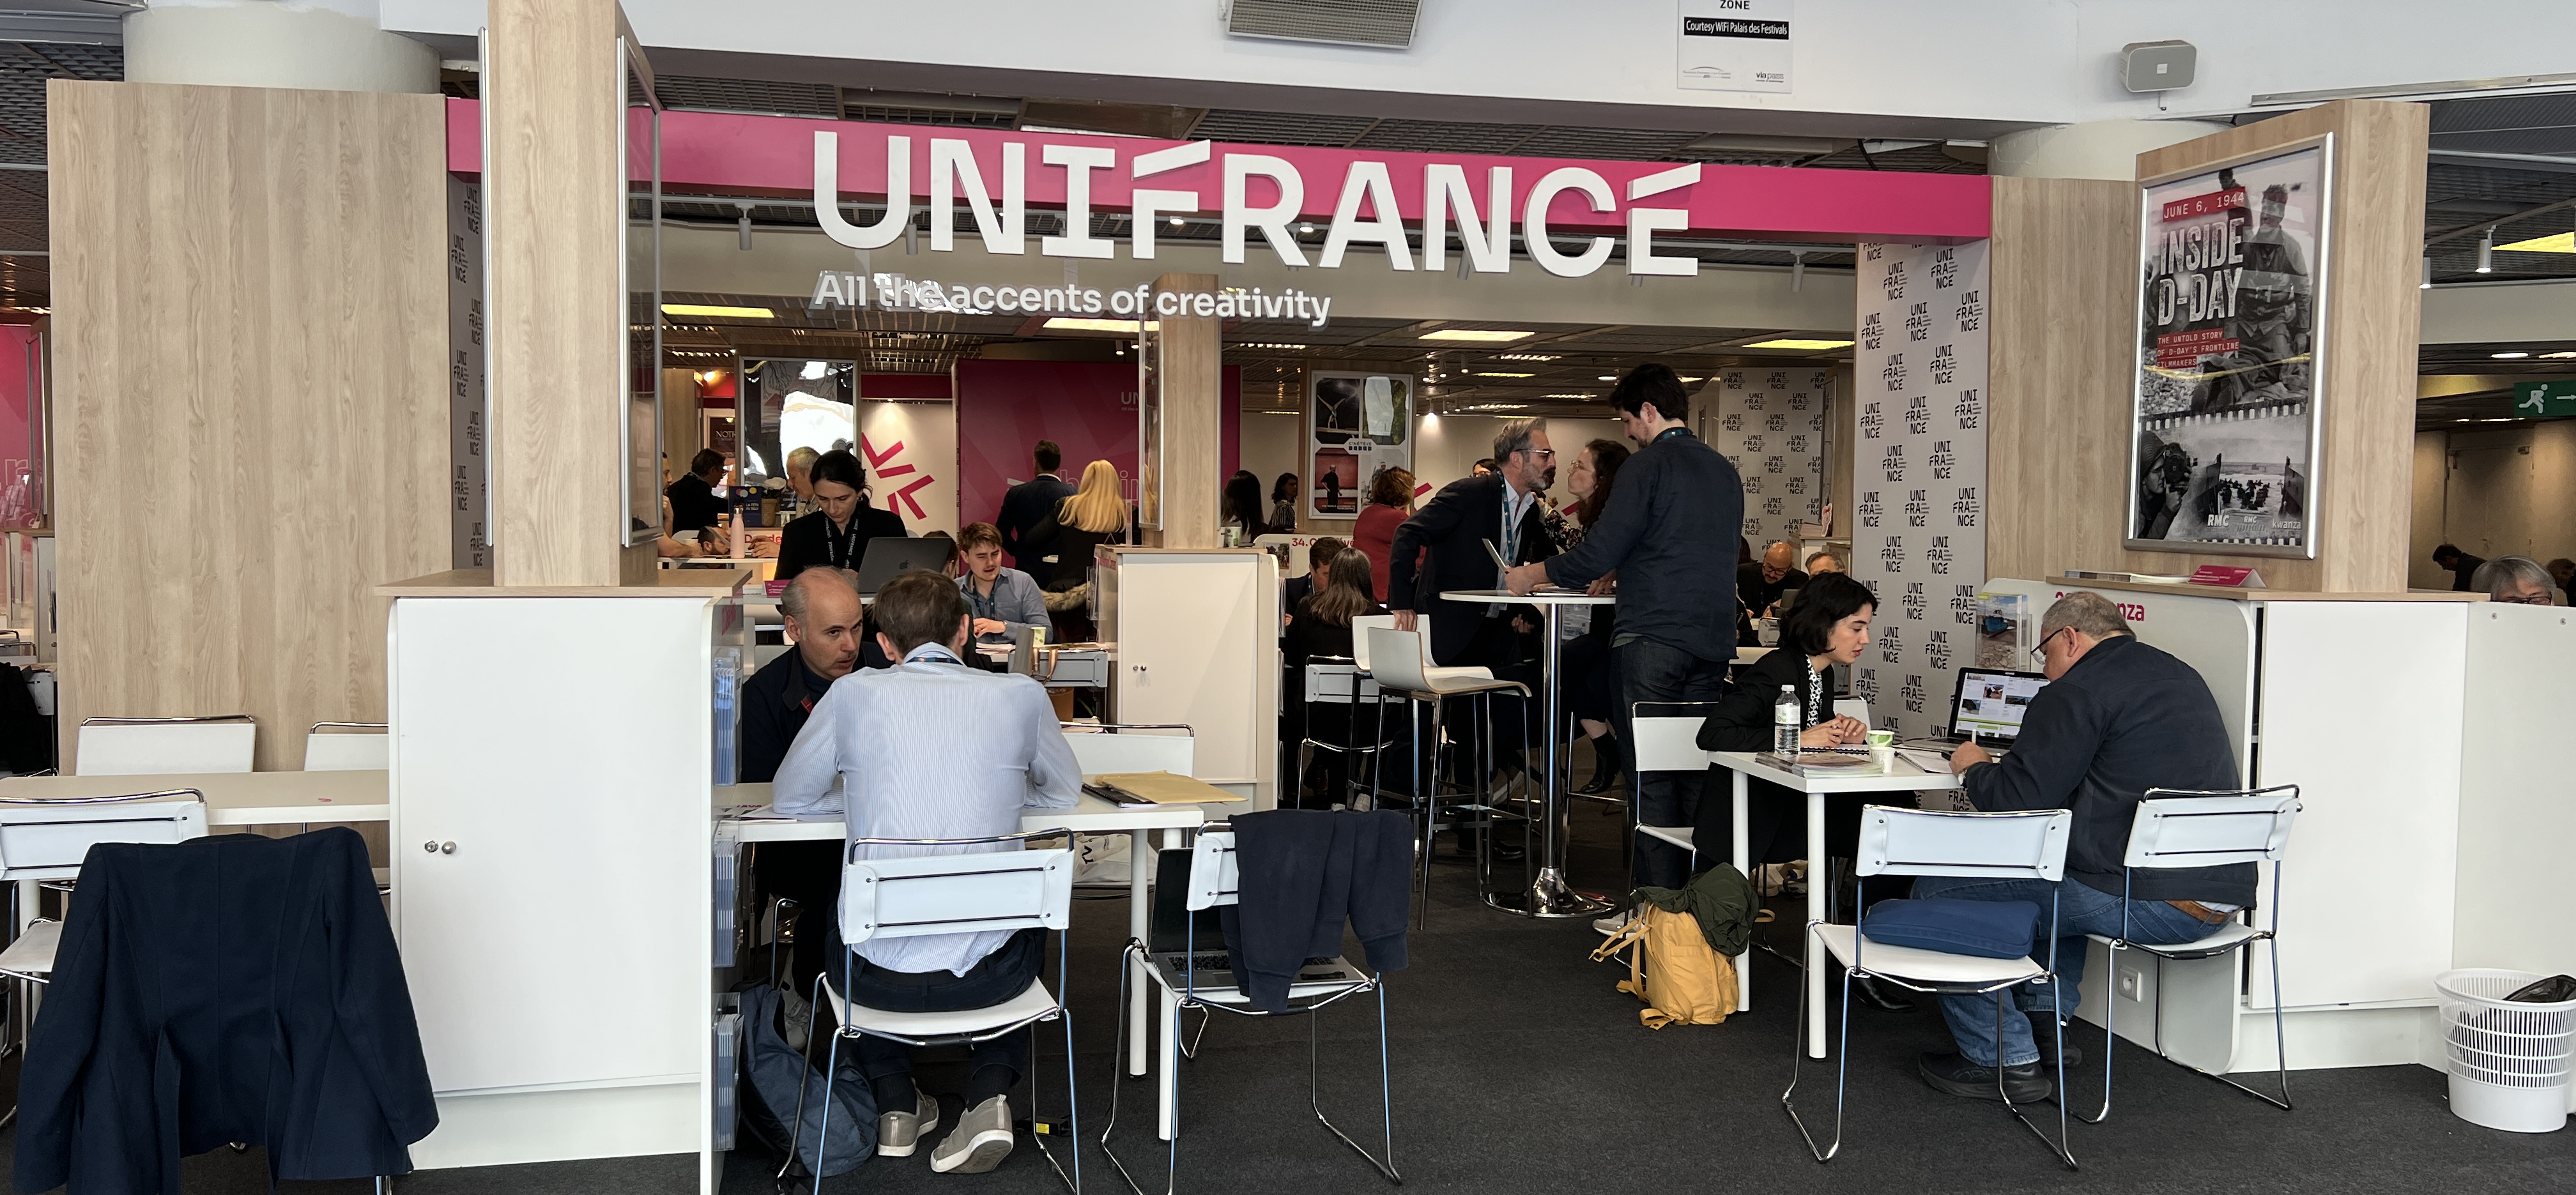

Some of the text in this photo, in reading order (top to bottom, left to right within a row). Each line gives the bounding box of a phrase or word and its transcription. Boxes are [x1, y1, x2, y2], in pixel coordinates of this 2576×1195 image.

[1720, 0, 1750, 10] ZONE
[1686, 20, 1788, 35] Courtesy WiFi Palais des Festivals
[2164, 192, 2244, 218] JUNE 6, 1944
[2160, 217, 2244, 275] INSIDE
[1937, 248, 1954, 263] UNI
[1889, 262, 1903, 275] UNI
[813, 275, 1331, 327] All the accents of creativity
[1962, 291, 1979, 305] UNI
[2158, 267, 2243, 326] D-DAY
[1912, 302, 1927, 316] UNI
[1866, 313, 1880, 326] UNI
[2174, 333, 2198, 343] UNTOLD
[2202, 331, 2223, 340] STORY
[1936, 345, 1952, 358] UNI
[2169, 346, 2197, 355] D-DAY'S
[2201, 341, 2239, 352] FRONTLINE
[1889, 354, 1903, 367] UNI
[2157, 358, 2196, 367] FILMMAKERS
[1911, 396, 1926, 409] UNI
[1961, 390, 1977, 402] UNI
[1866, 402, 1880, 415] UNI
[1887, 445, 1903, 457] UNI
[1935, 441, 1951, 453] UNI
[1864, 492, 1879, 503] UNI
[1910, 490, 1926, 501] UNI
[1959, 488, 1975, 499] UNI
[2207, 514, 2229, 526] RMC
[2272, 518, 2301, 529] kwanza
[1887, 537, 1901, 547] UNI
[1933, 537, 1949, 548] UNI
[1908, 582, 1923, 594] UNI
[1956, 585, 1974, 597] UNI
[1884, 626, 1899, 638] UNI
[1931, 631, 1947, 643] UNI
[1861, 668, 1875, 680] UNI
[1906, 674, 1922, 687] UNI
[1883, 716, 1899, 729] UNI
[1931, 725, 1947, 738] UNI
